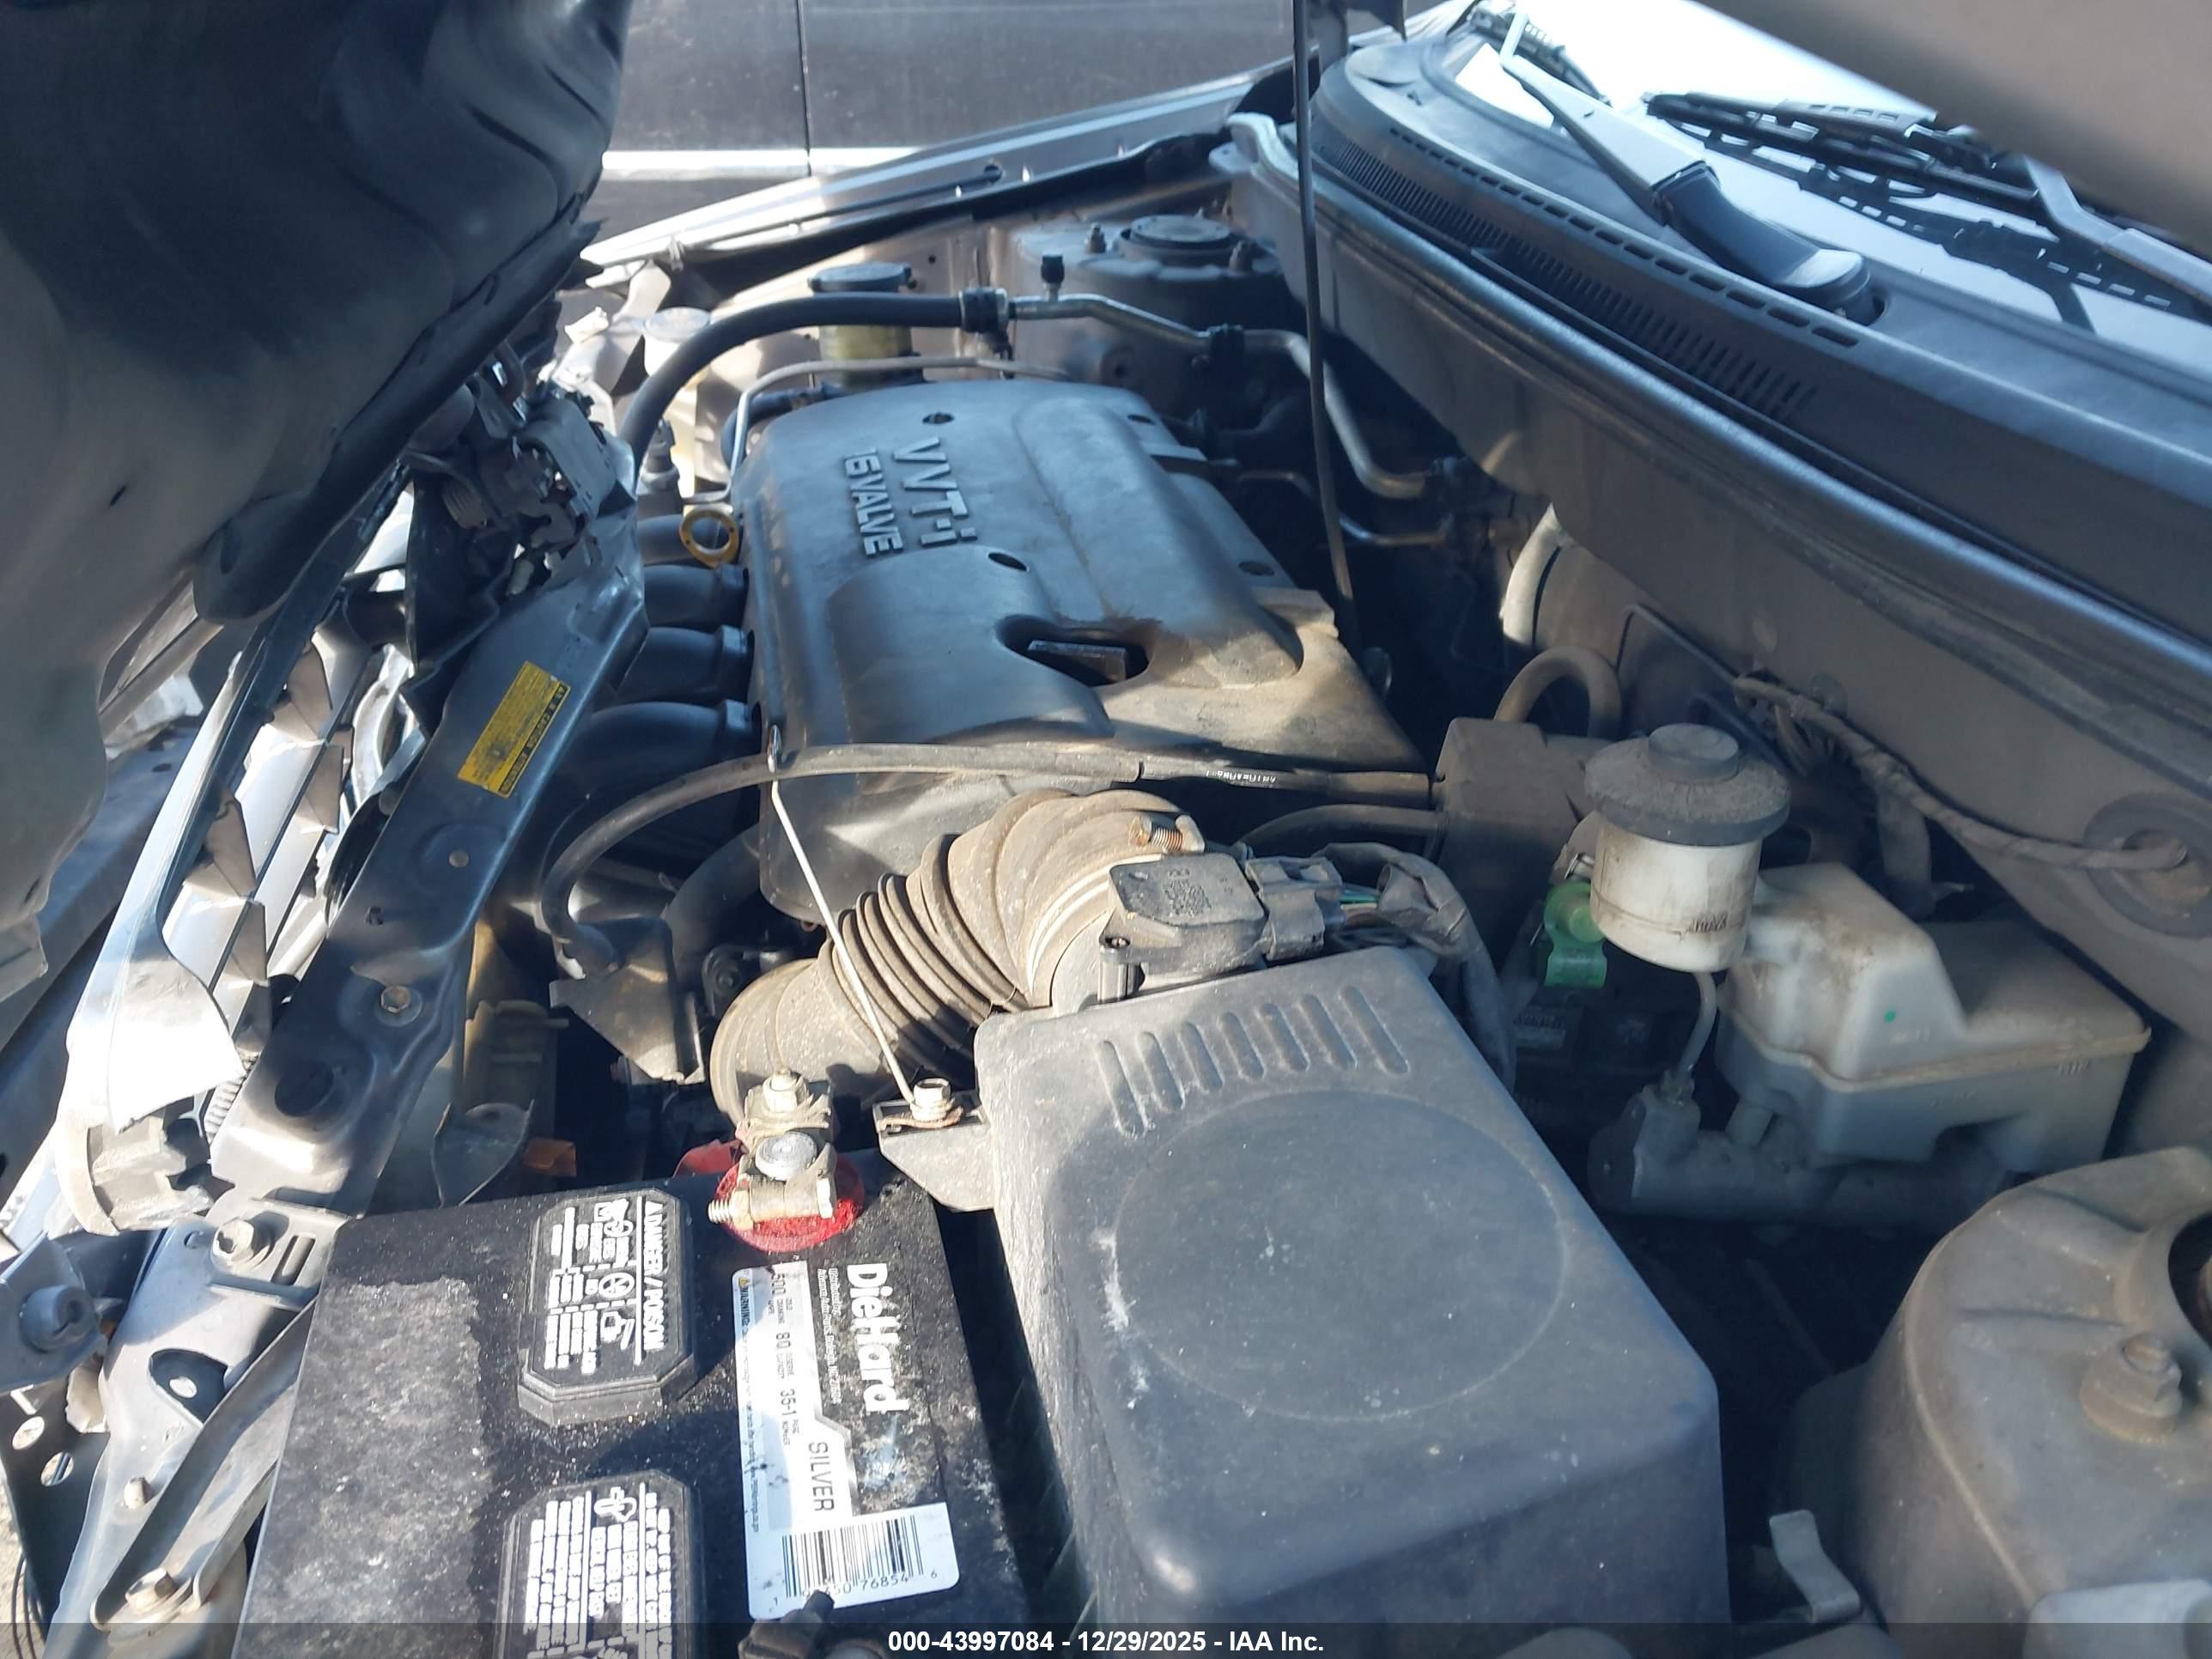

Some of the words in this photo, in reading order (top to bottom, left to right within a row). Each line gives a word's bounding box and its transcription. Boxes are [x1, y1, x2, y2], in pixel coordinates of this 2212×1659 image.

[893, 436, 977, 548] VVT-i
[643, 1214, 664, 1276] DANGER
[770, 1273, 787, 1295] 500
[643, 1288, 665, 1351] POISON
[775, 1332, 791, 1348] 80
[847, 1262, 910, 1416] DieHard
[780, 1389, 797, 1416] 35-1
[808, 1441, 835, 1512] SILVER
[860, 1575, 909, 1590] 76854
[930, 1569, 938, 1579] 6
